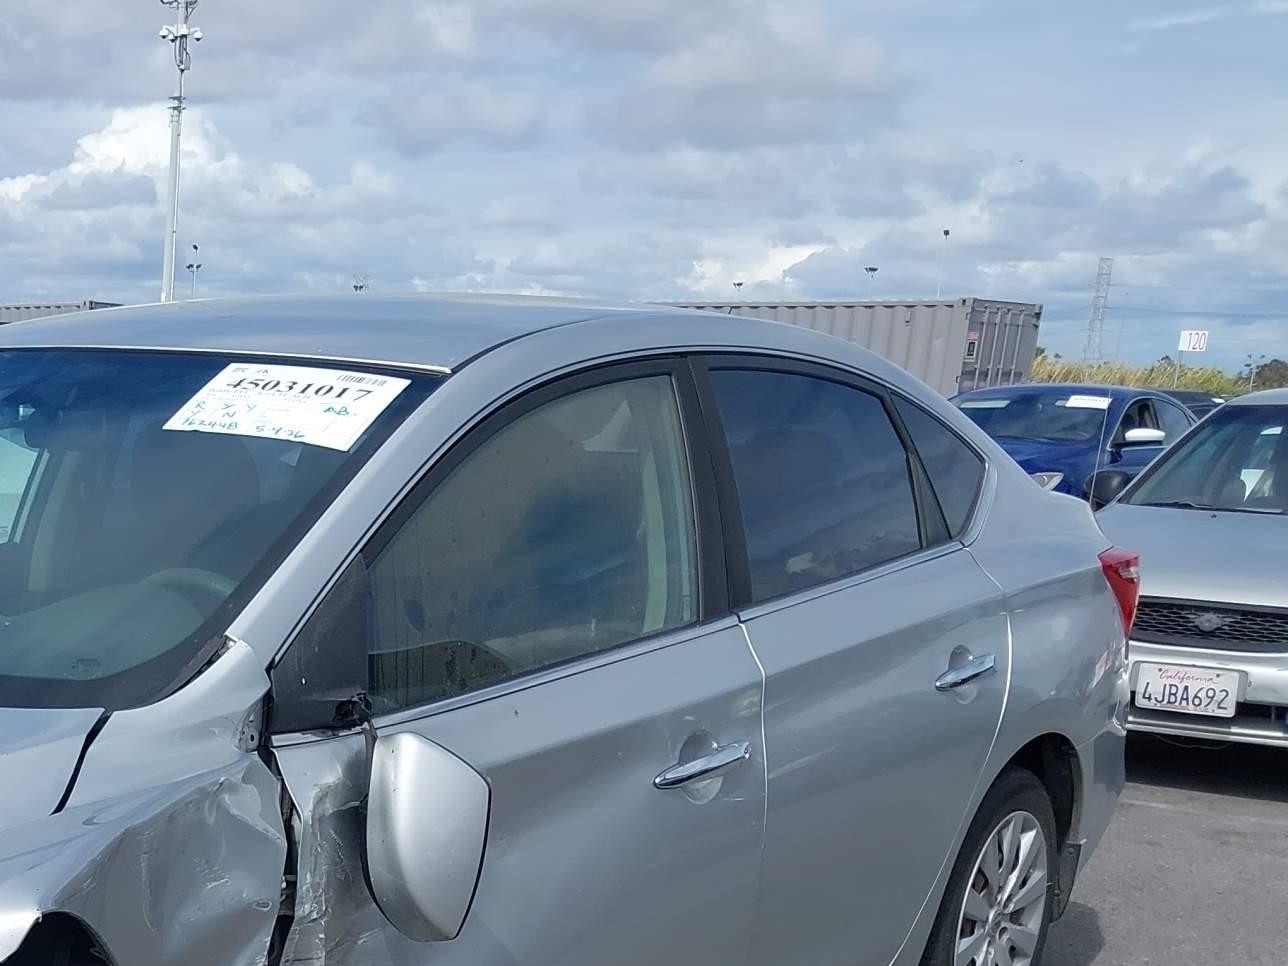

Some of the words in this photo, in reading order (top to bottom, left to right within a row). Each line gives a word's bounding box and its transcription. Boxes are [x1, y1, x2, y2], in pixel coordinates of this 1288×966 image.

[1187, 332, 1207, 350] 120
[225, 378, 374, 402] 45031017
[1159, 669, 1219, 684] California
[1141, 681, 1230, 710] 4JBA692
